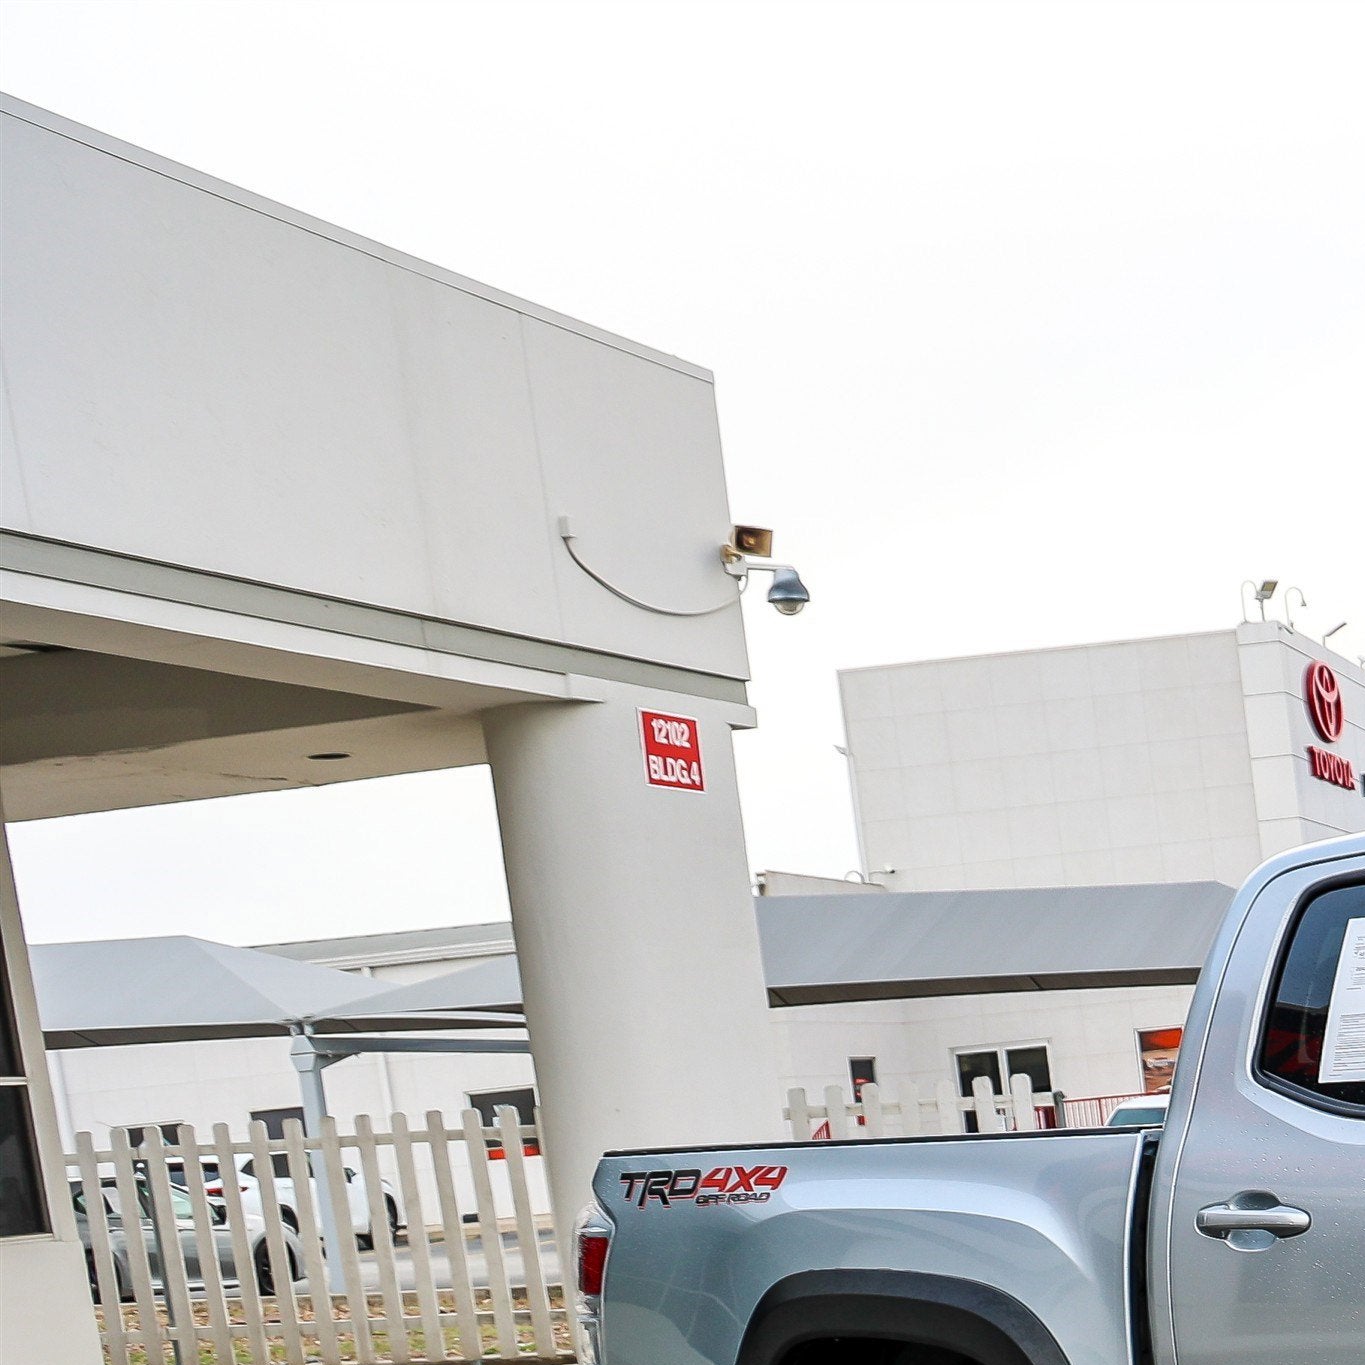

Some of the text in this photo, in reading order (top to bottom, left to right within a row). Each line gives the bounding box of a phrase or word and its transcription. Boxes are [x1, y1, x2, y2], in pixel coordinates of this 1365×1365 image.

[1307, 745, 1356, 791] TOYOTA
[619, 1168, 702, 1211] TRD
[695, 1191, 771, 1207] OFF ROAD
